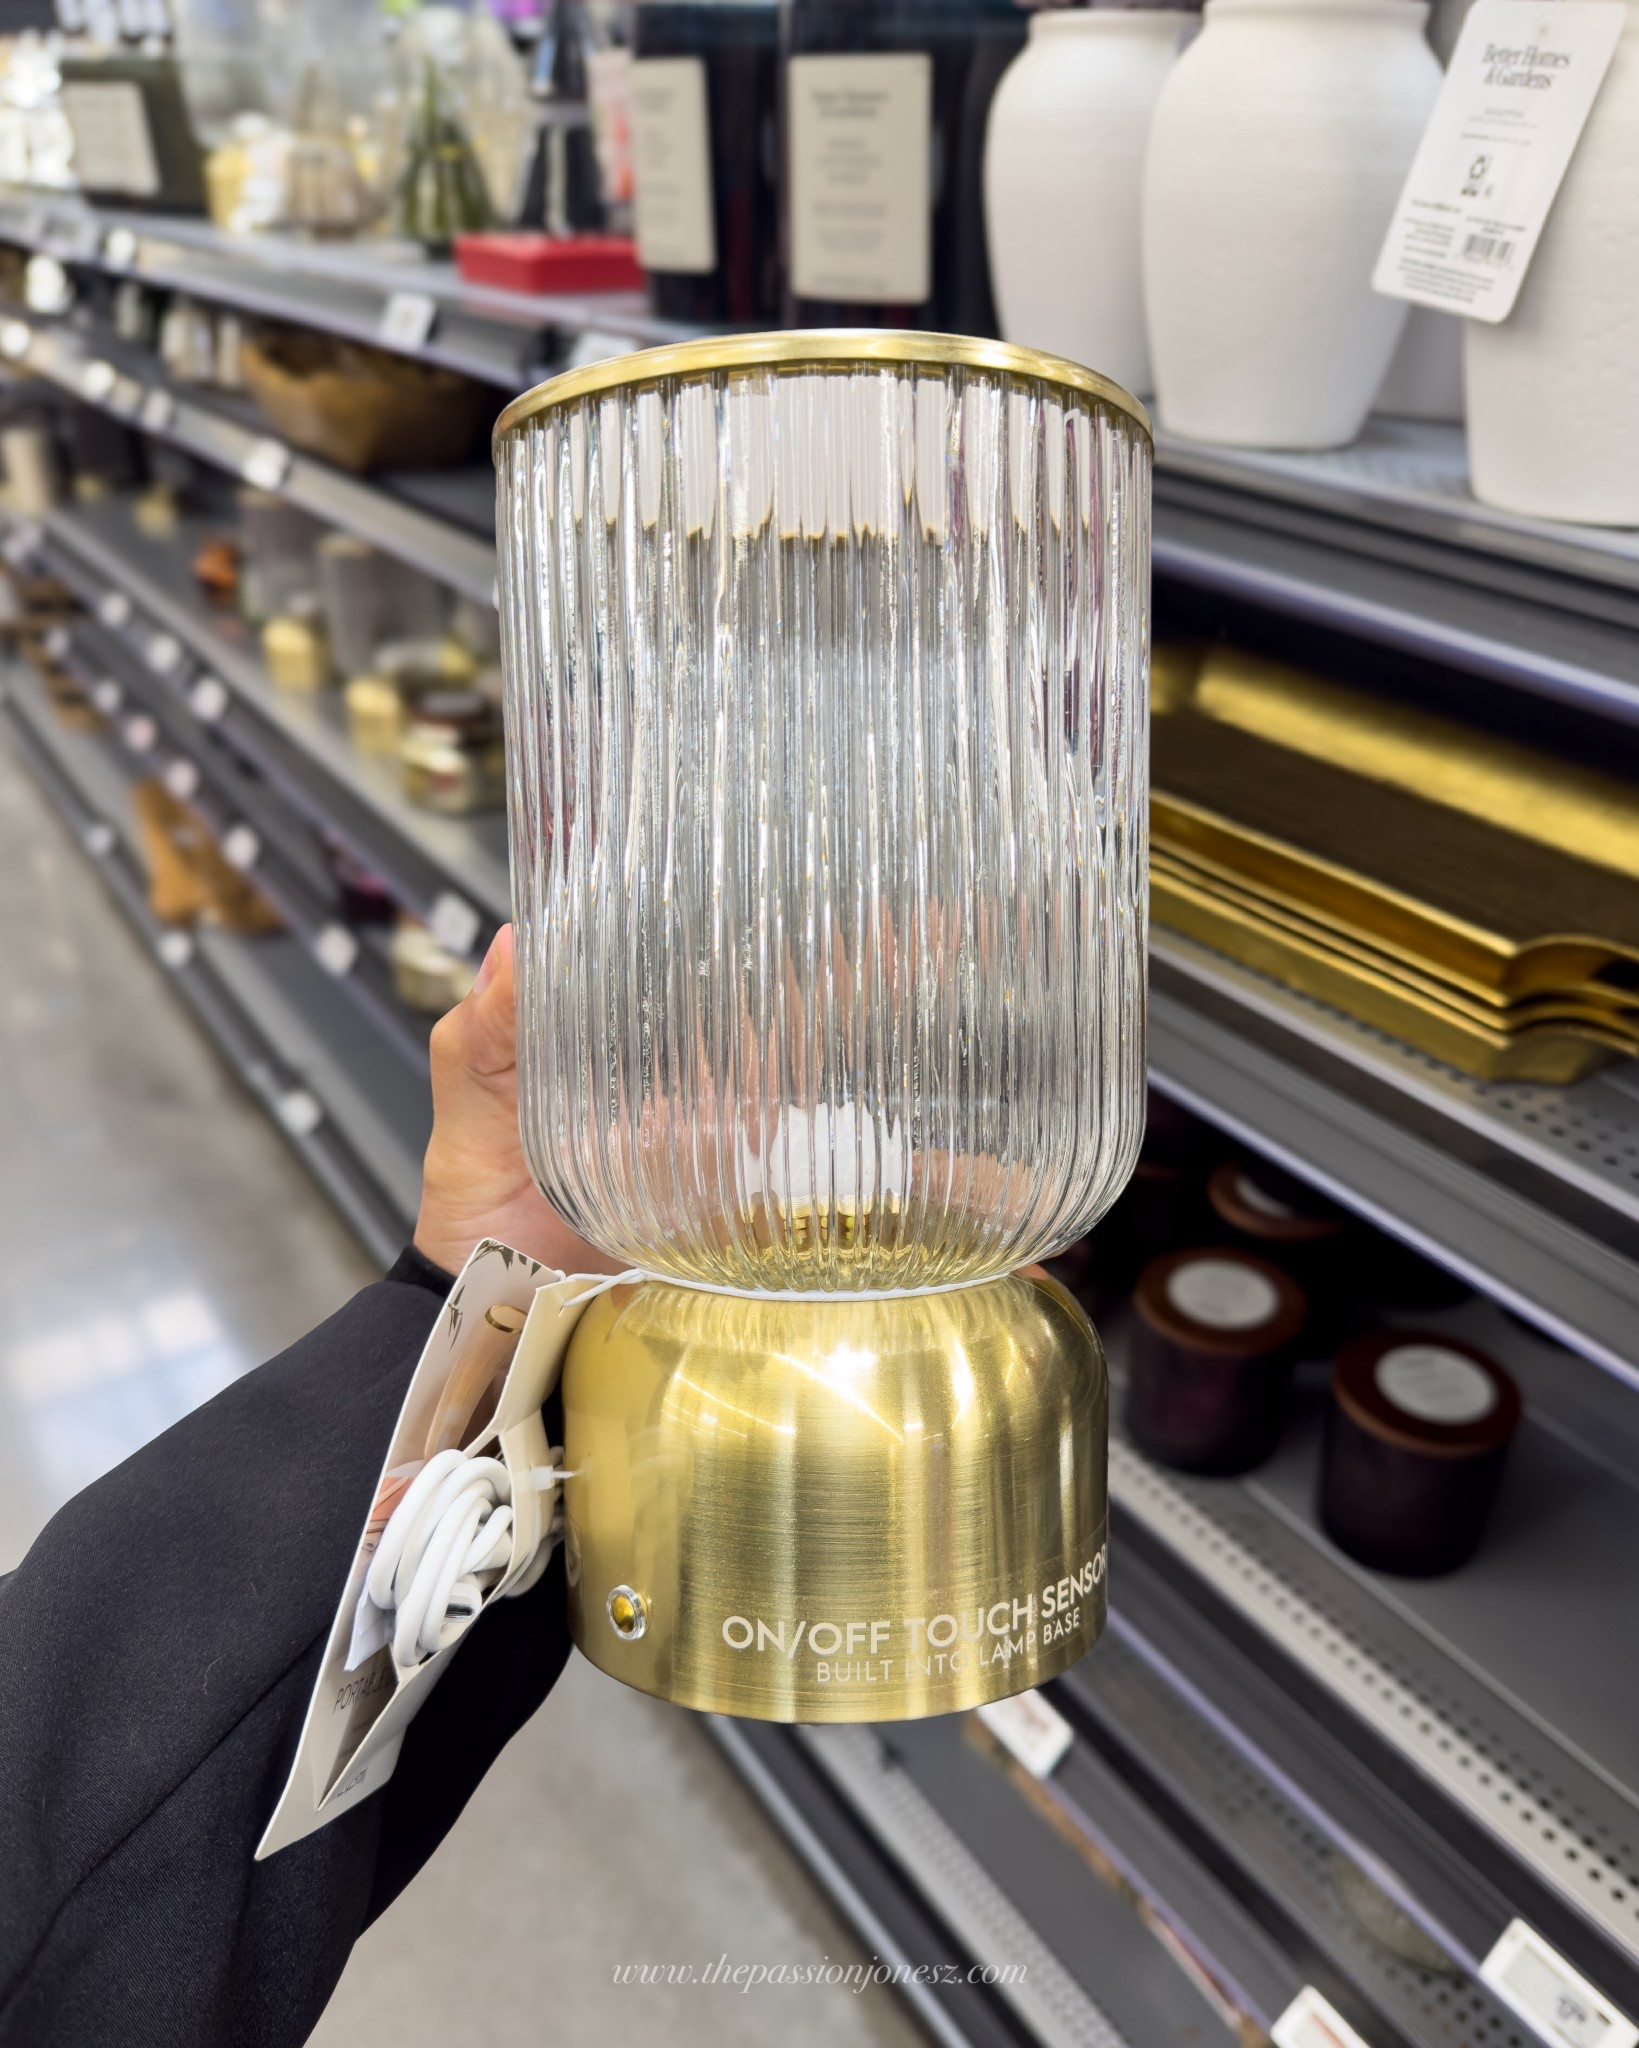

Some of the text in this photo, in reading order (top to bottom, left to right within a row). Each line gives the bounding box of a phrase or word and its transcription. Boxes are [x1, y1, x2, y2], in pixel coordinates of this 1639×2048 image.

[722, 1543, 1107, 1660] ON/OFF TOUCH SENSOR
[817, 1606, 1080, 1682] BUILT INTO LAMP BASE
[333, 1666, 387, 1713] PORTABLE
